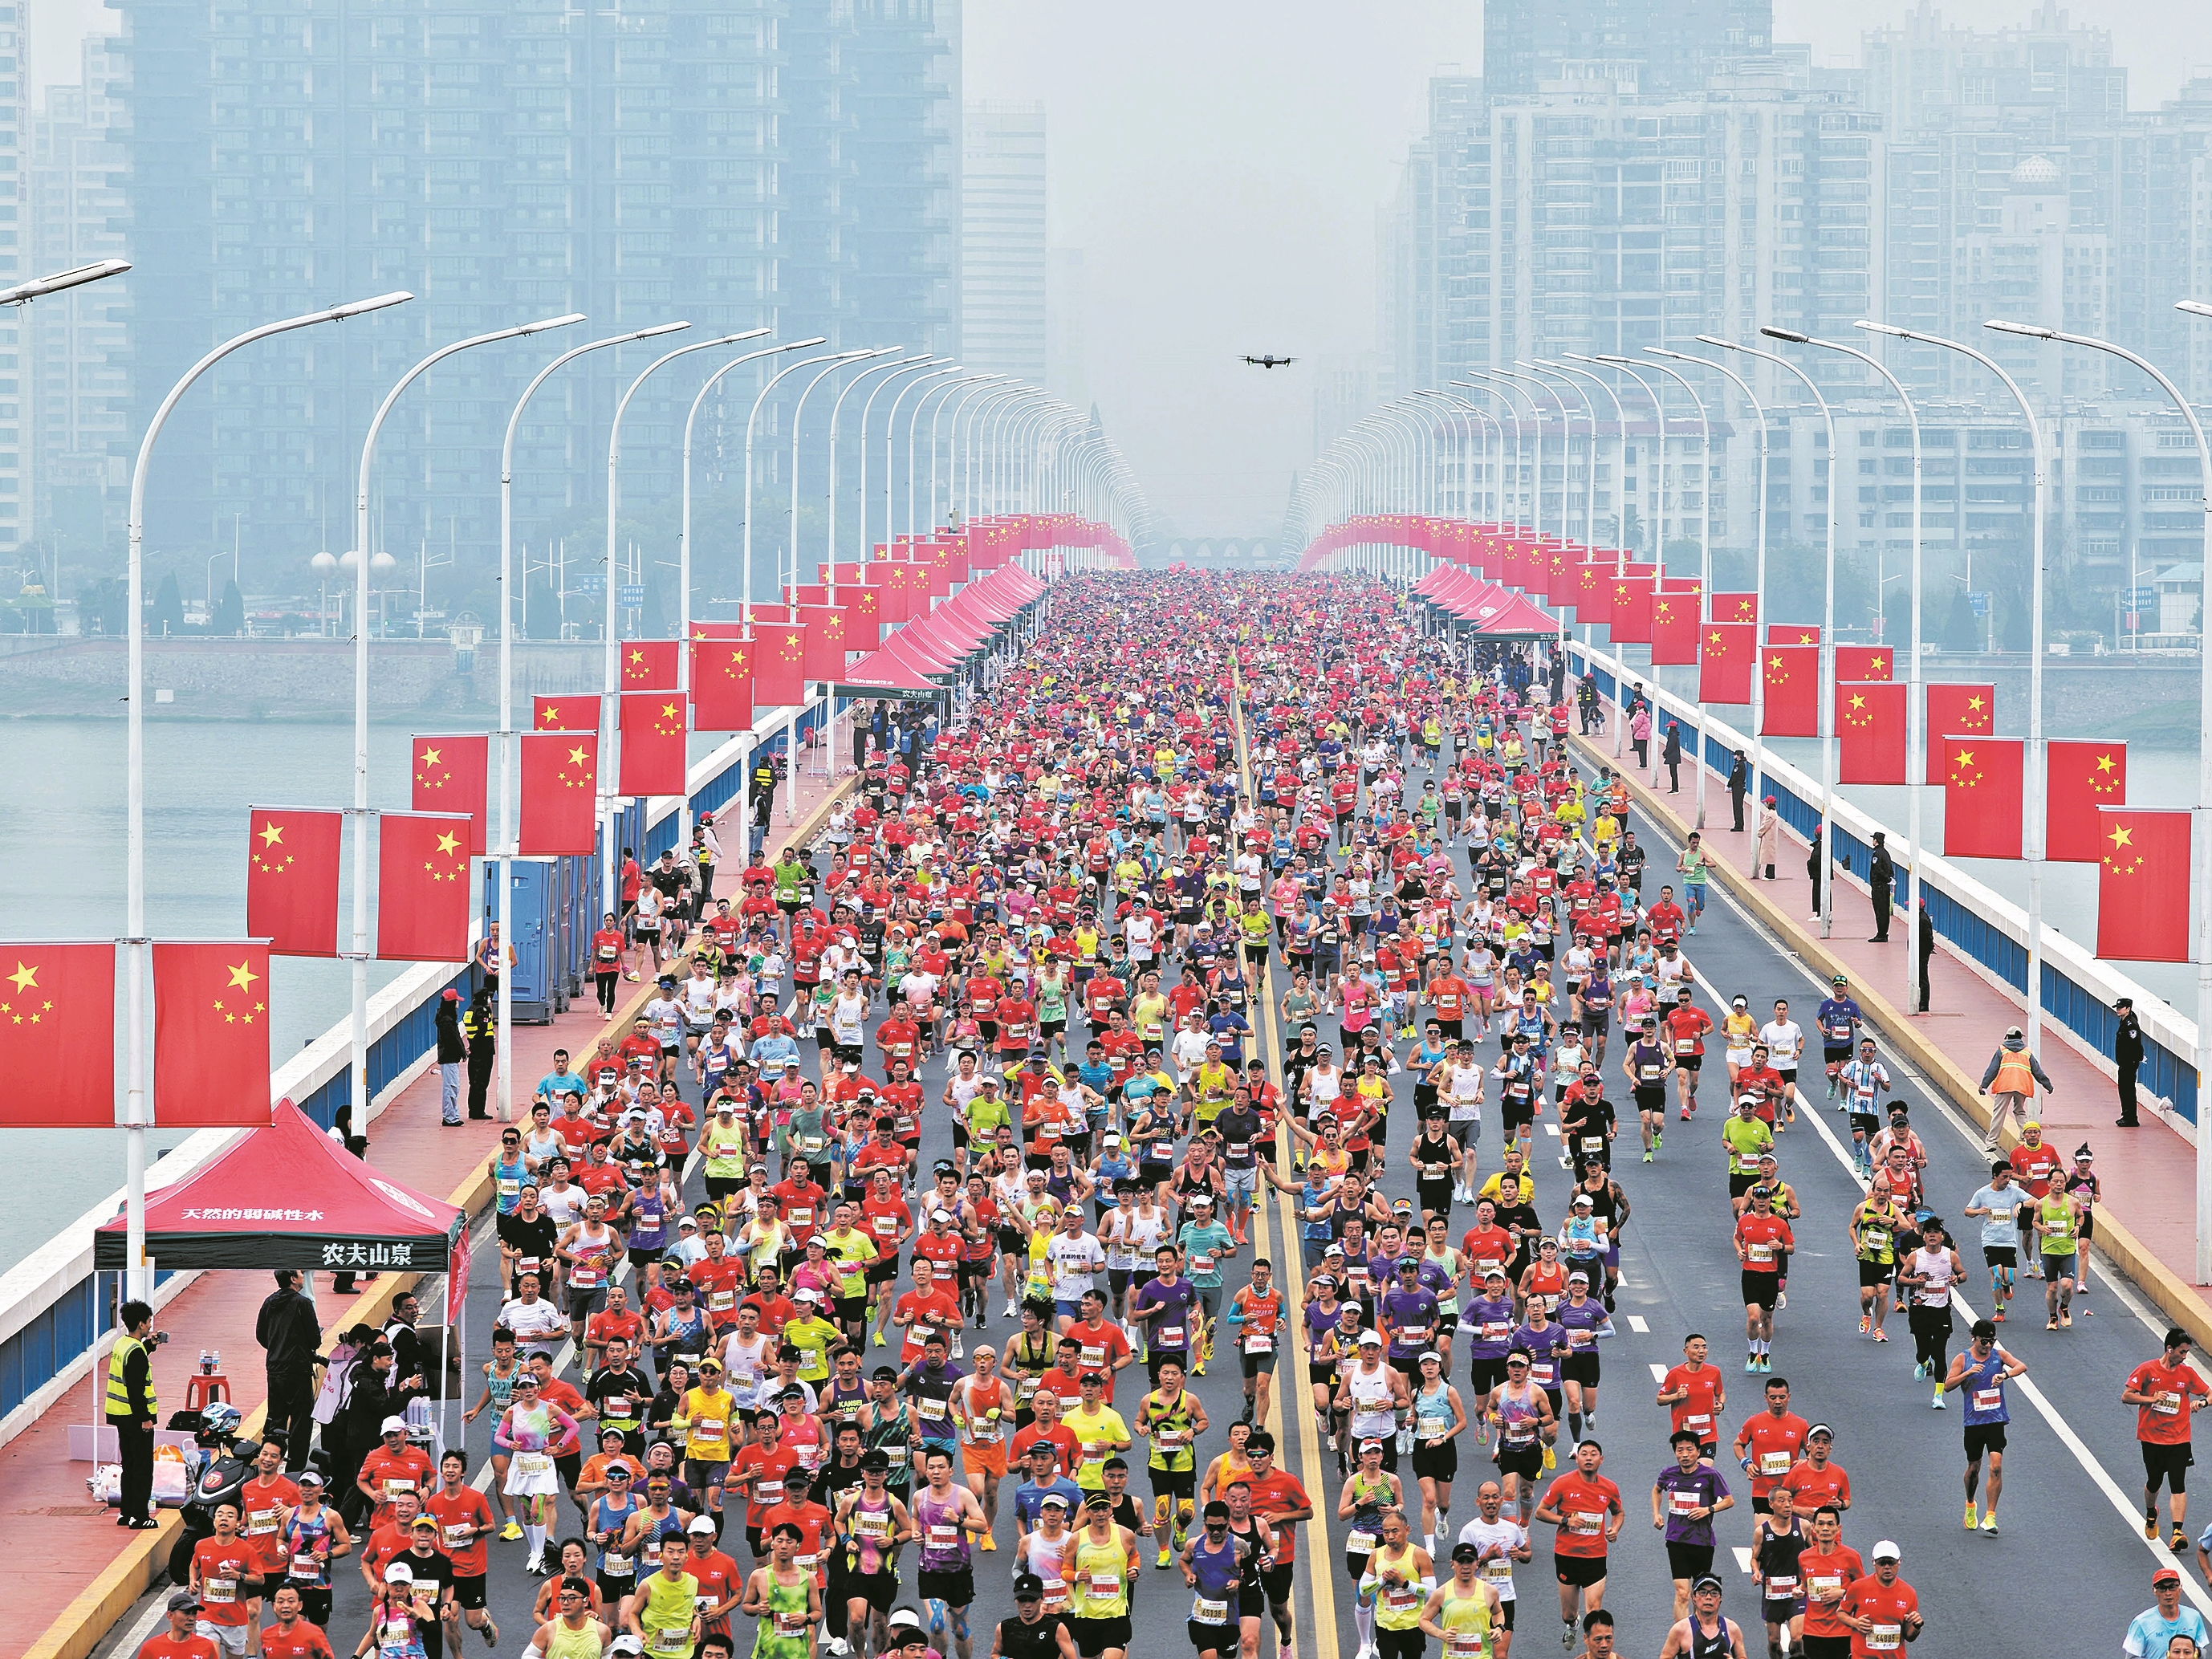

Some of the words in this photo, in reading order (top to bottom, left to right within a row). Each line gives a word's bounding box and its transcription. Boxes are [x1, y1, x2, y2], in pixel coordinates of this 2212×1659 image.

[181, 1208, 324, 1222] 天然的弱碱性水
[321, 1242, 413, 1267] 农夫山泉
[1768, 1460, 1786, 1470] 61935
[206, 1476, 218, 1484] 07
[863, 1520, 881, 1529] 64551
[1490, 1568, 1507, 1576] 61383
[1202, 1608, 1222, 1618] 65138
